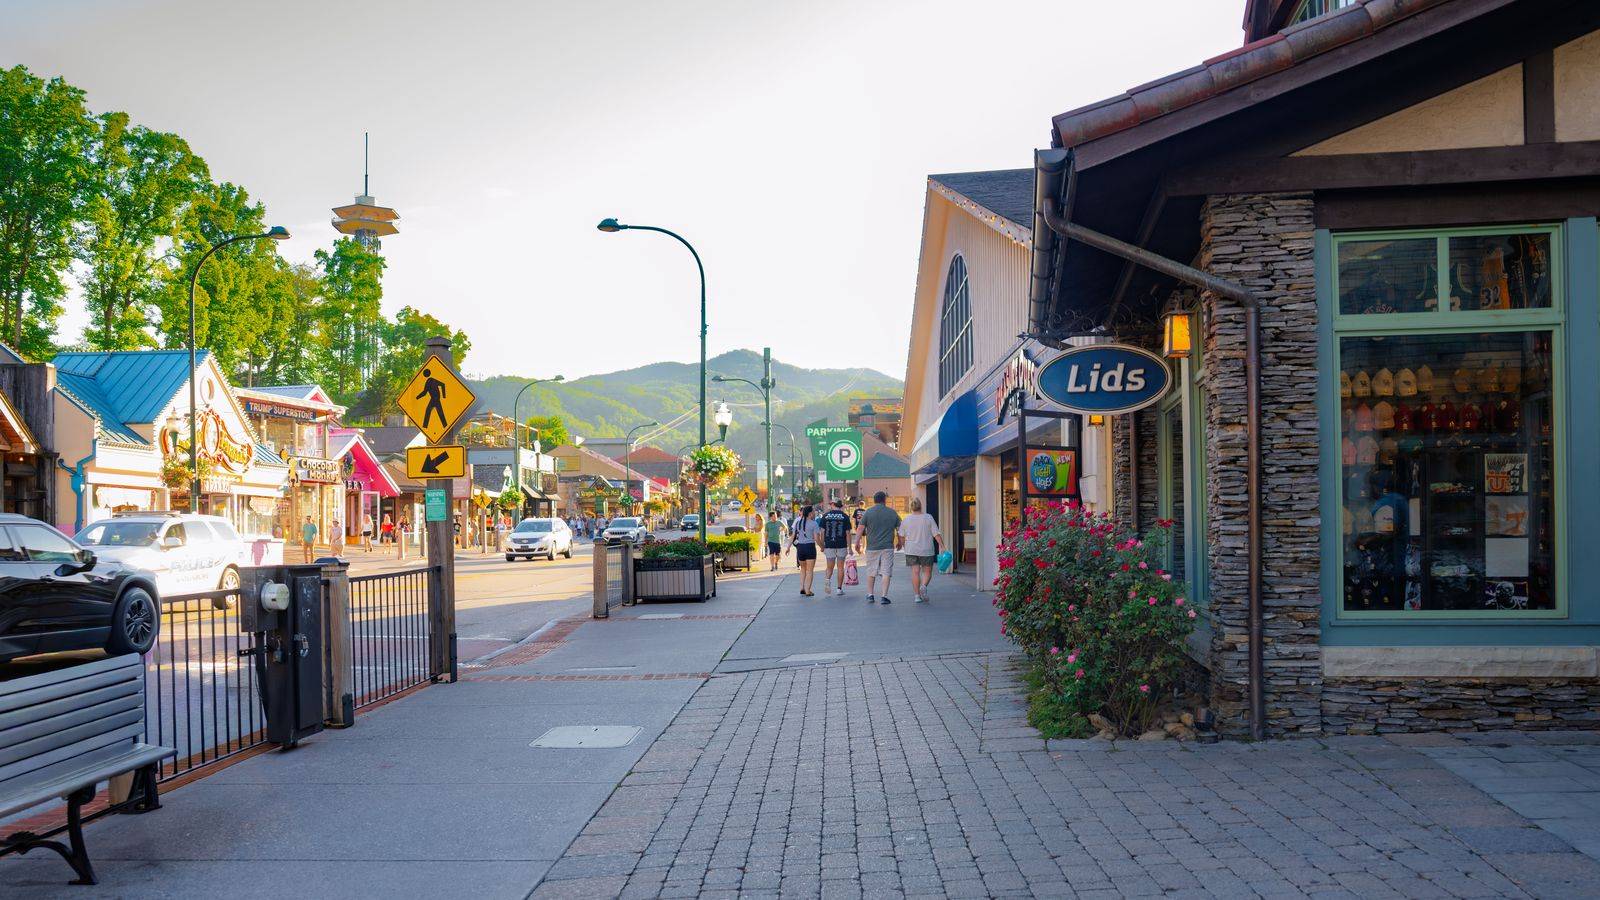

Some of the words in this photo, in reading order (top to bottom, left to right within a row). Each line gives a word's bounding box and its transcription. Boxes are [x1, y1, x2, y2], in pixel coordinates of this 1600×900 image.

[1067, 362, 1146, 393] Lids
[273, 405, 314, 420] SUPERSTORE
[839, 448, 852, 465] P
[1055, 454, 1072, 466] NEW
[346, 480, 365, 491] ERY
